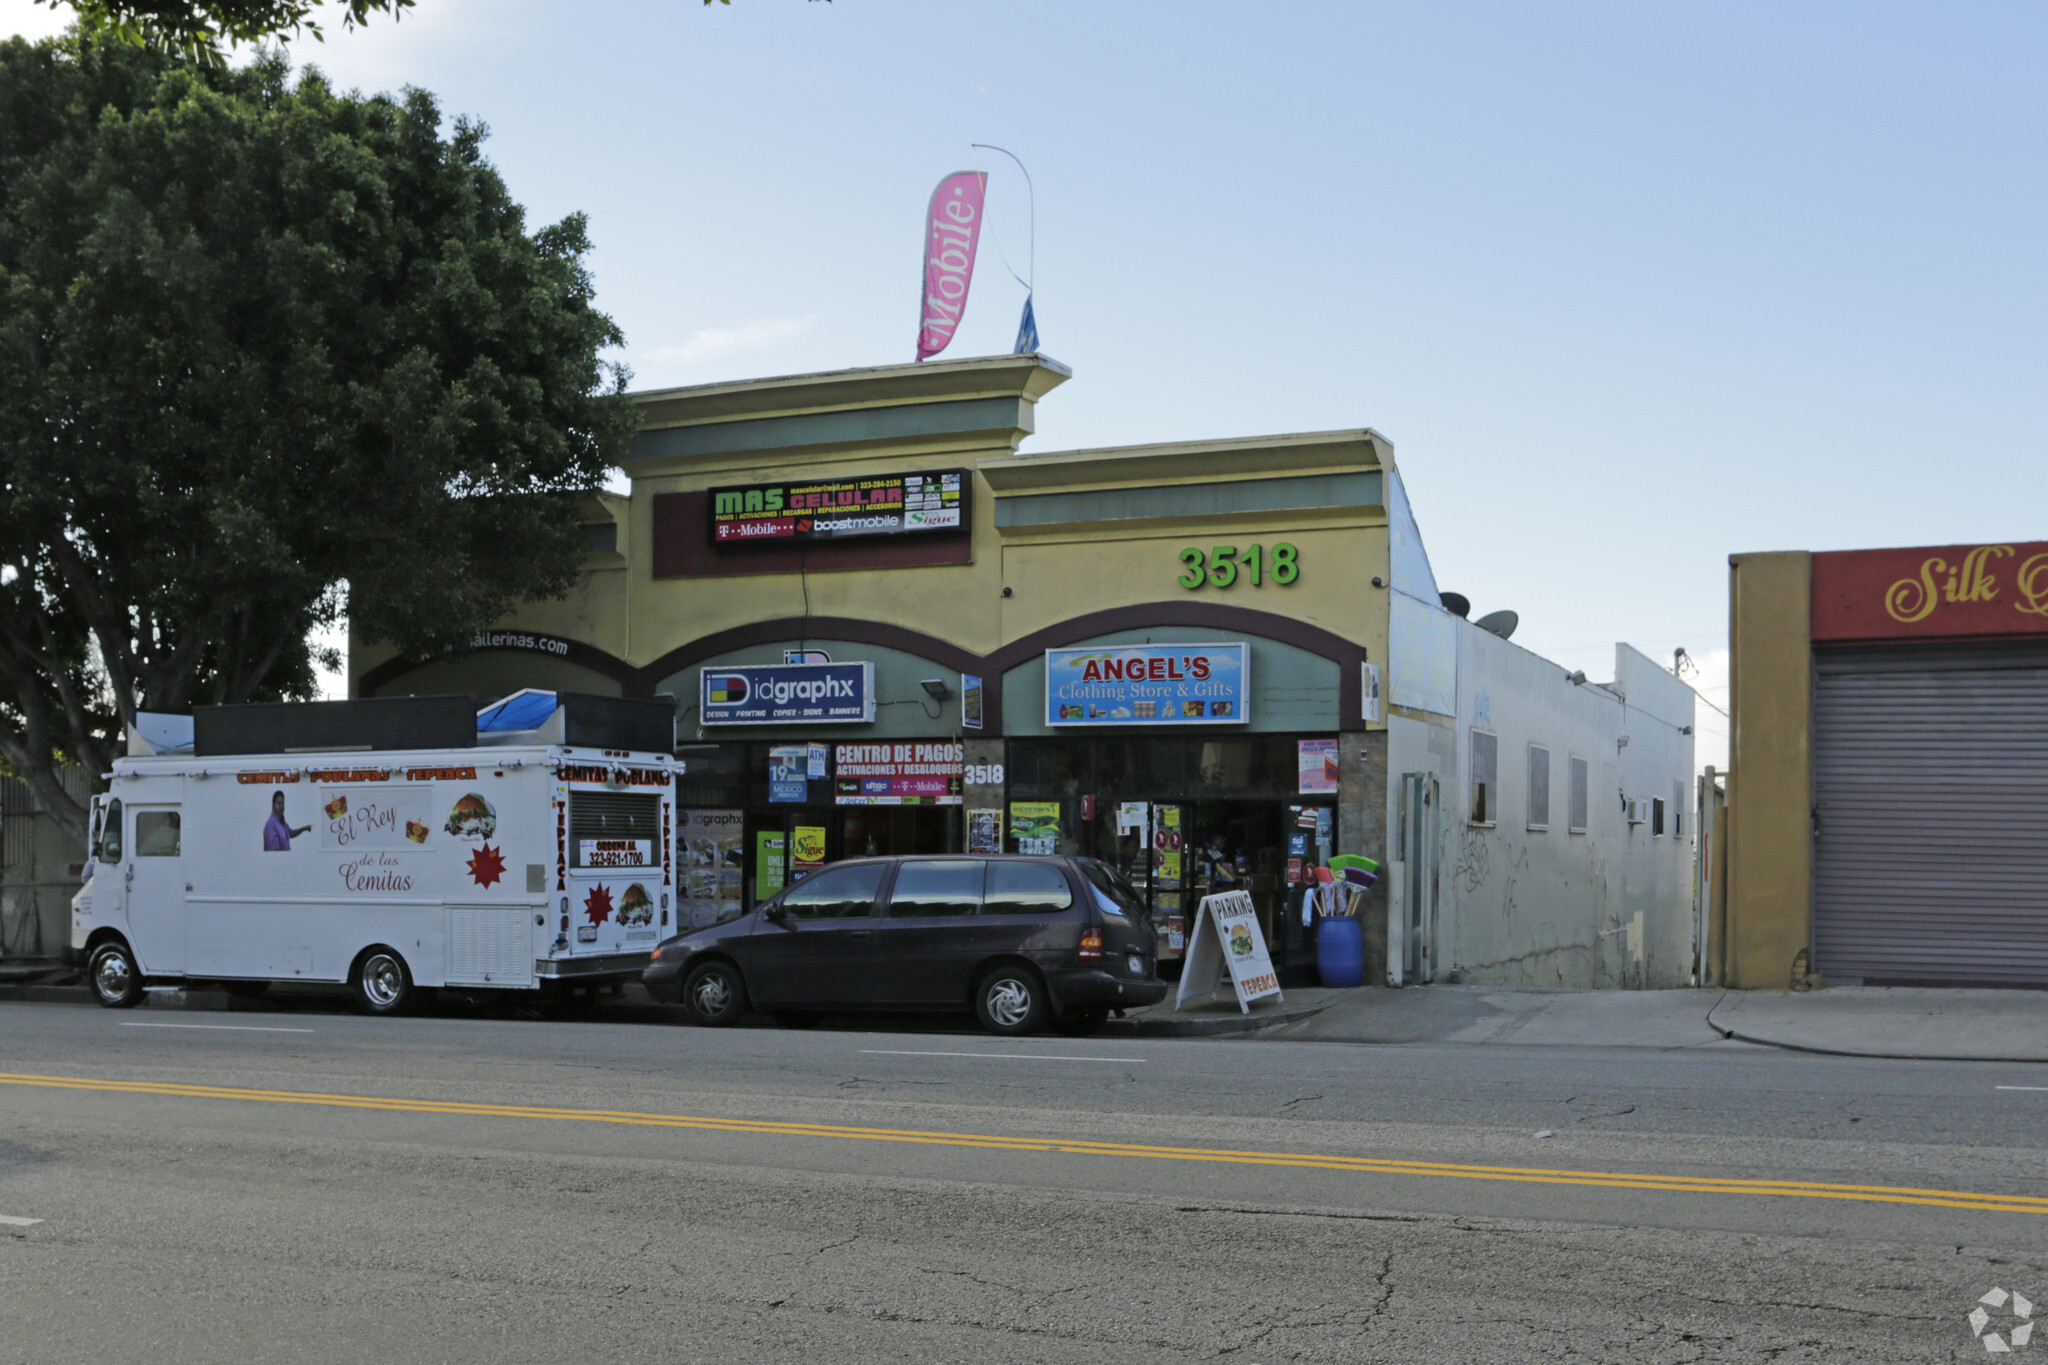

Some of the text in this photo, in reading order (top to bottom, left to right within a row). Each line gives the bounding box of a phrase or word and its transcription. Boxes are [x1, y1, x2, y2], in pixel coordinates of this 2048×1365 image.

[924, 199, 975, 337] Mobile
[715, 488, 902, 514] MAS CELULAR
[738, 511, 778, 519] ACTIVACIONES
[782, 508, 812, 516] RECARGAS
[817, 505, 861, 514] REPARACIONES
[866, 502, 902, 511] ACCESORIOS
[1178, 542, 1299, 589] 3518
[1885, 545, 2016, 623] Silk
[1082, 656, 1212, 683] ANGEL'S
[1059, 681, 1234, 701] Clothing Store & Gifts
[706, 707, 861, 718] DESIGN PRINTING COPIES SIGNS BANNERS
[809, 749, 825, 761] ATM
[836, 744, 963, 763] CENTRO DE PAGOS
[236, 766, 477, 784] CEMITAS POBLANAS TEPEACA
[556, 765, 670, 786] CEMITAS POBLANAS
[770, 765, 788, 781] 19
[837, 764, 963, 775] ACTIVACIONES Y DESBLOQUEOS
[964, 764, 1004, 785] 3518
[330, 803, 397, 846] El Rey
[359, 852, 400, 866] de las
[339, 861, 414, 891] Cemitas
[1214, 893, 1253, 920] PARKING
[1240, 973, 1279, 997] TEPEACA
